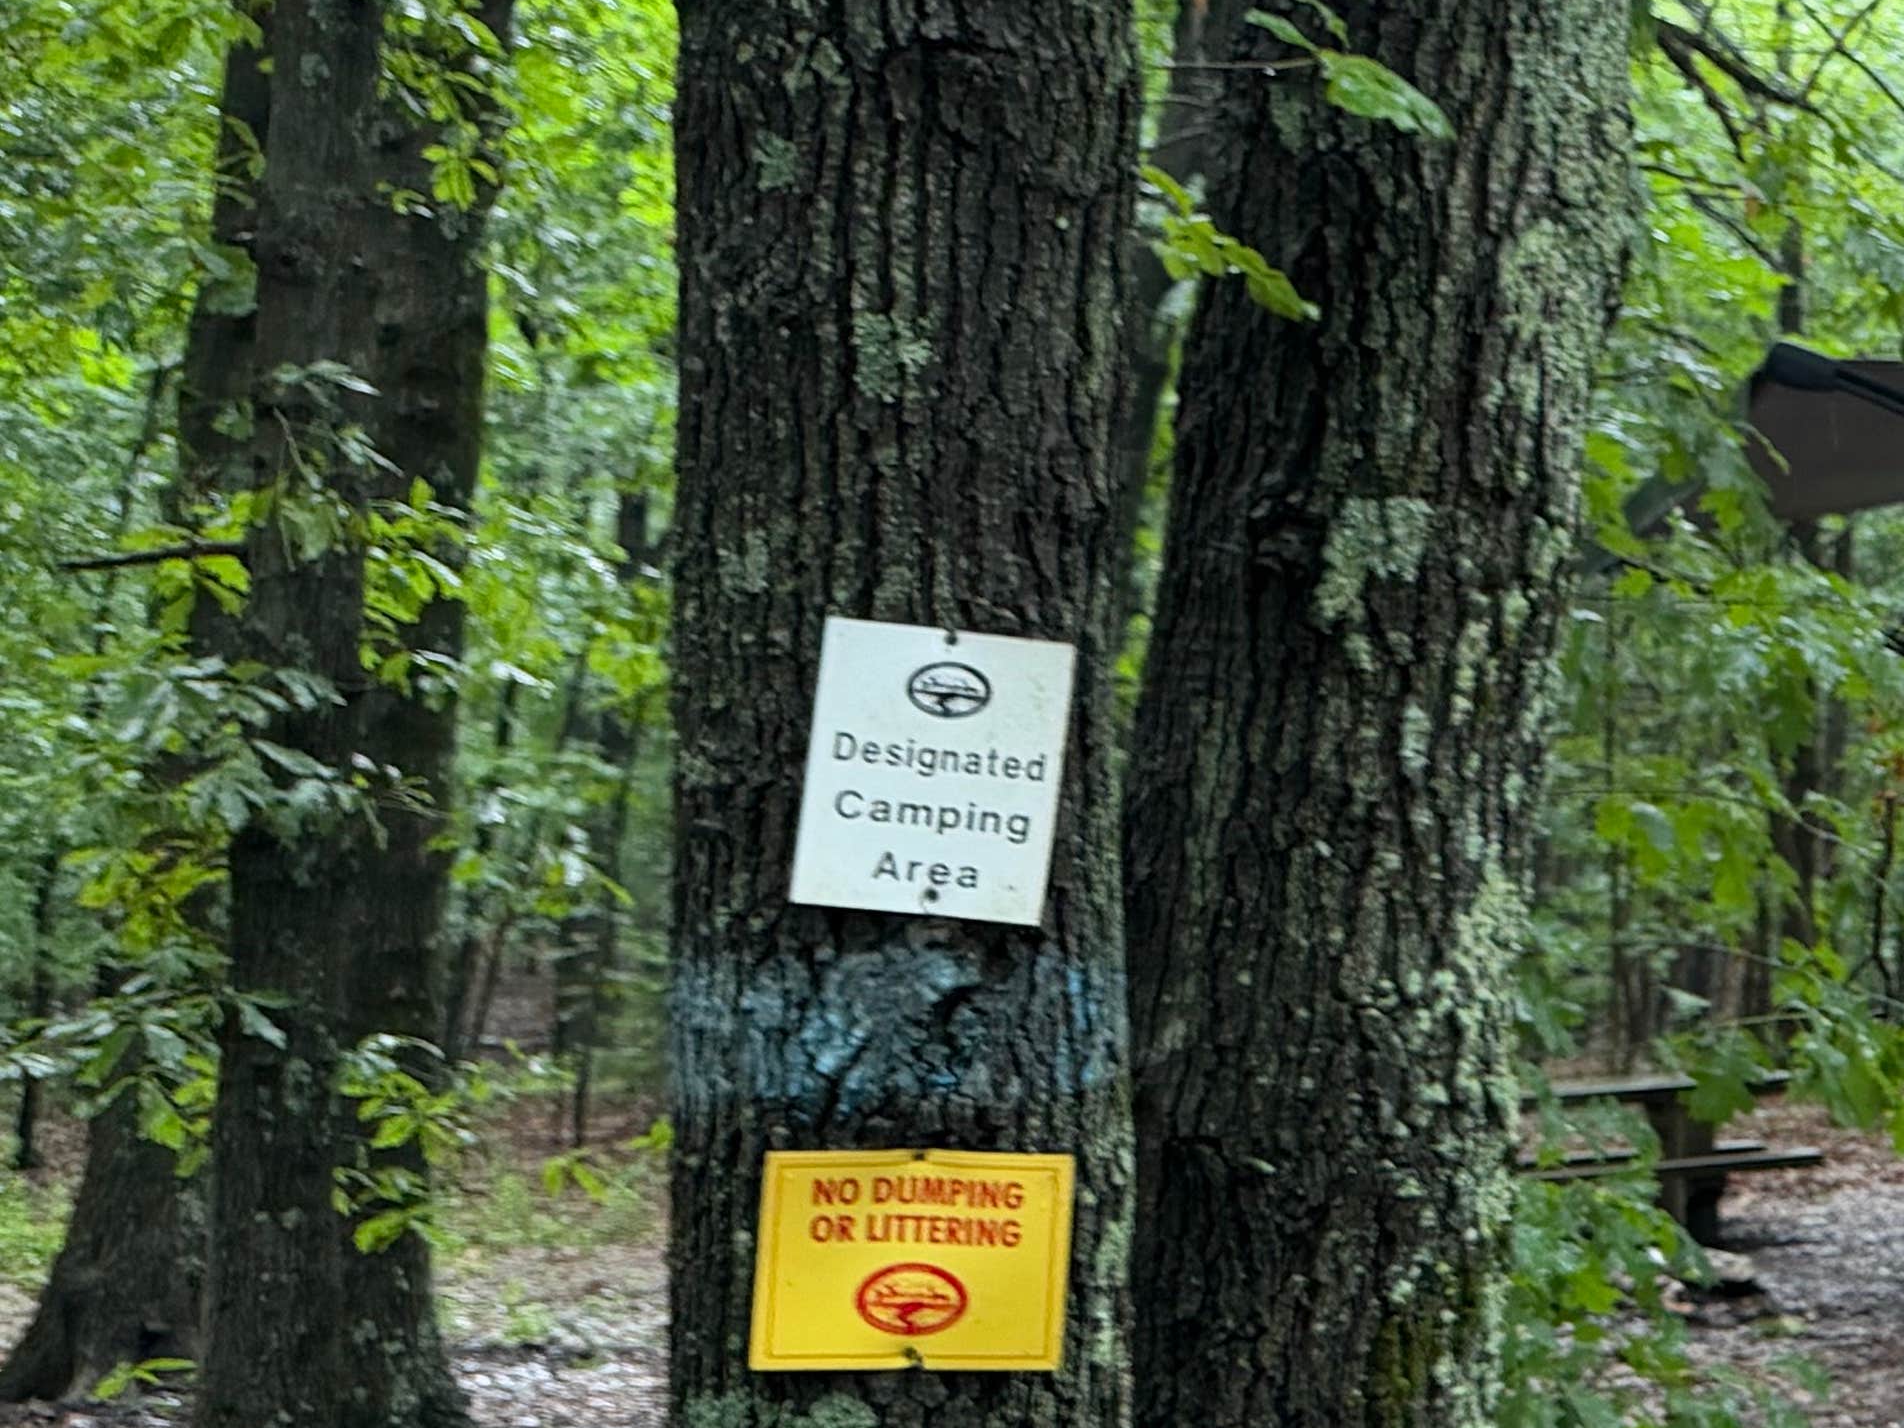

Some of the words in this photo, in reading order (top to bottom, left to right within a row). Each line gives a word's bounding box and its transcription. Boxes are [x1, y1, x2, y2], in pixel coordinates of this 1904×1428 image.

[832, 730, 1047, 782] Designated
[834, 789, 1030, 844] Camping
[871, 851, 979, 888] Area
[811, 1177, 860, 1206] NO
[871, 1175, 1024, 1209] DUMPING
[810, 1214, 856, 1243] OR
[865, 1213, 1022, 1248] LITTERING
